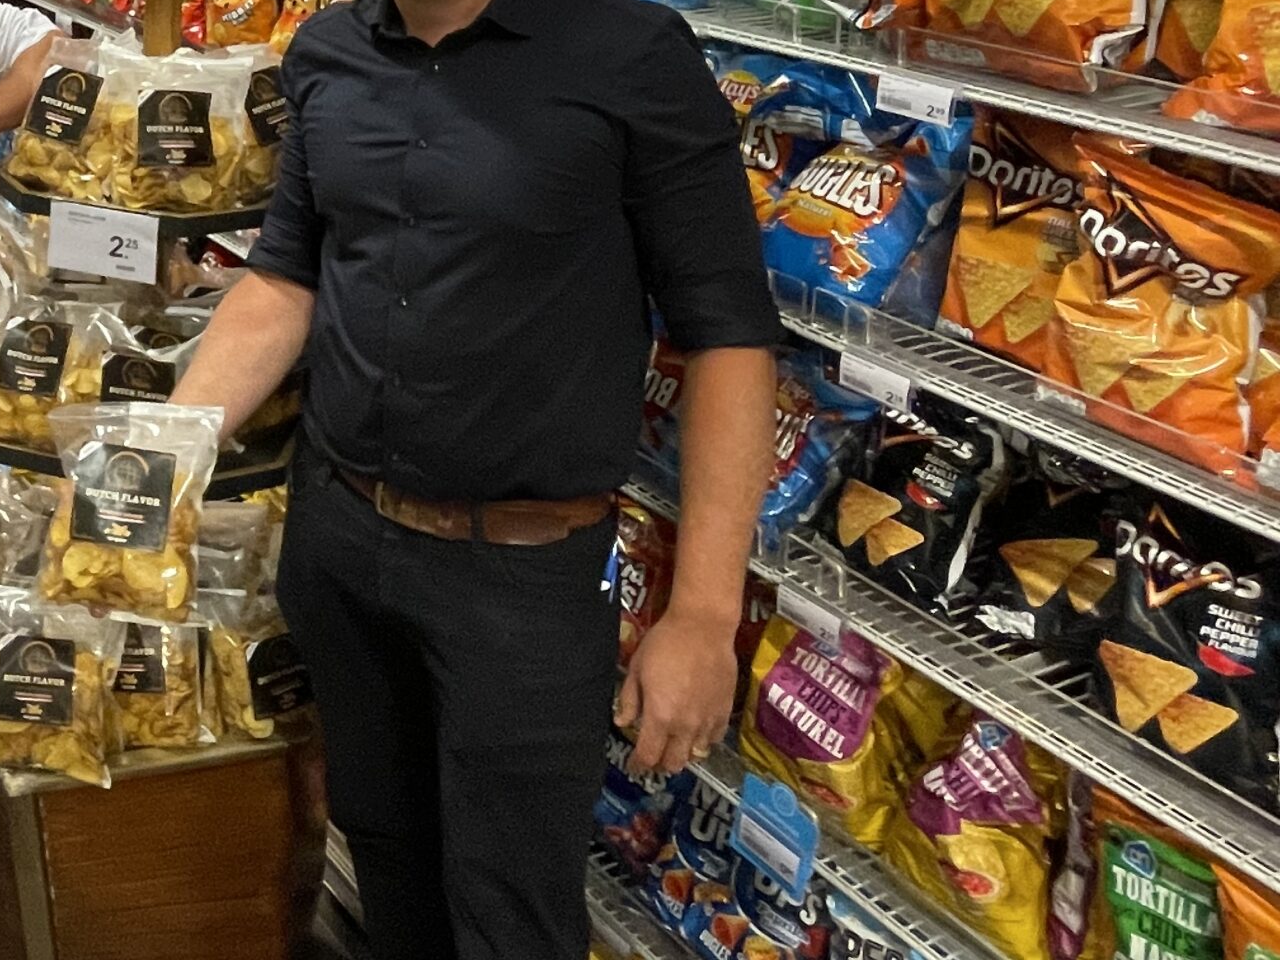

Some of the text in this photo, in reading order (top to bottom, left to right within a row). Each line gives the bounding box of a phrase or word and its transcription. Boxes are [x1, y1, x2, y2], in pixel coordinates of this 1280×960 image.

[121, 493, 161, 508] FLAVOR
[791, 646, 867, 714] TORTILLA
[768, 682, 845, 760] NATUREL
